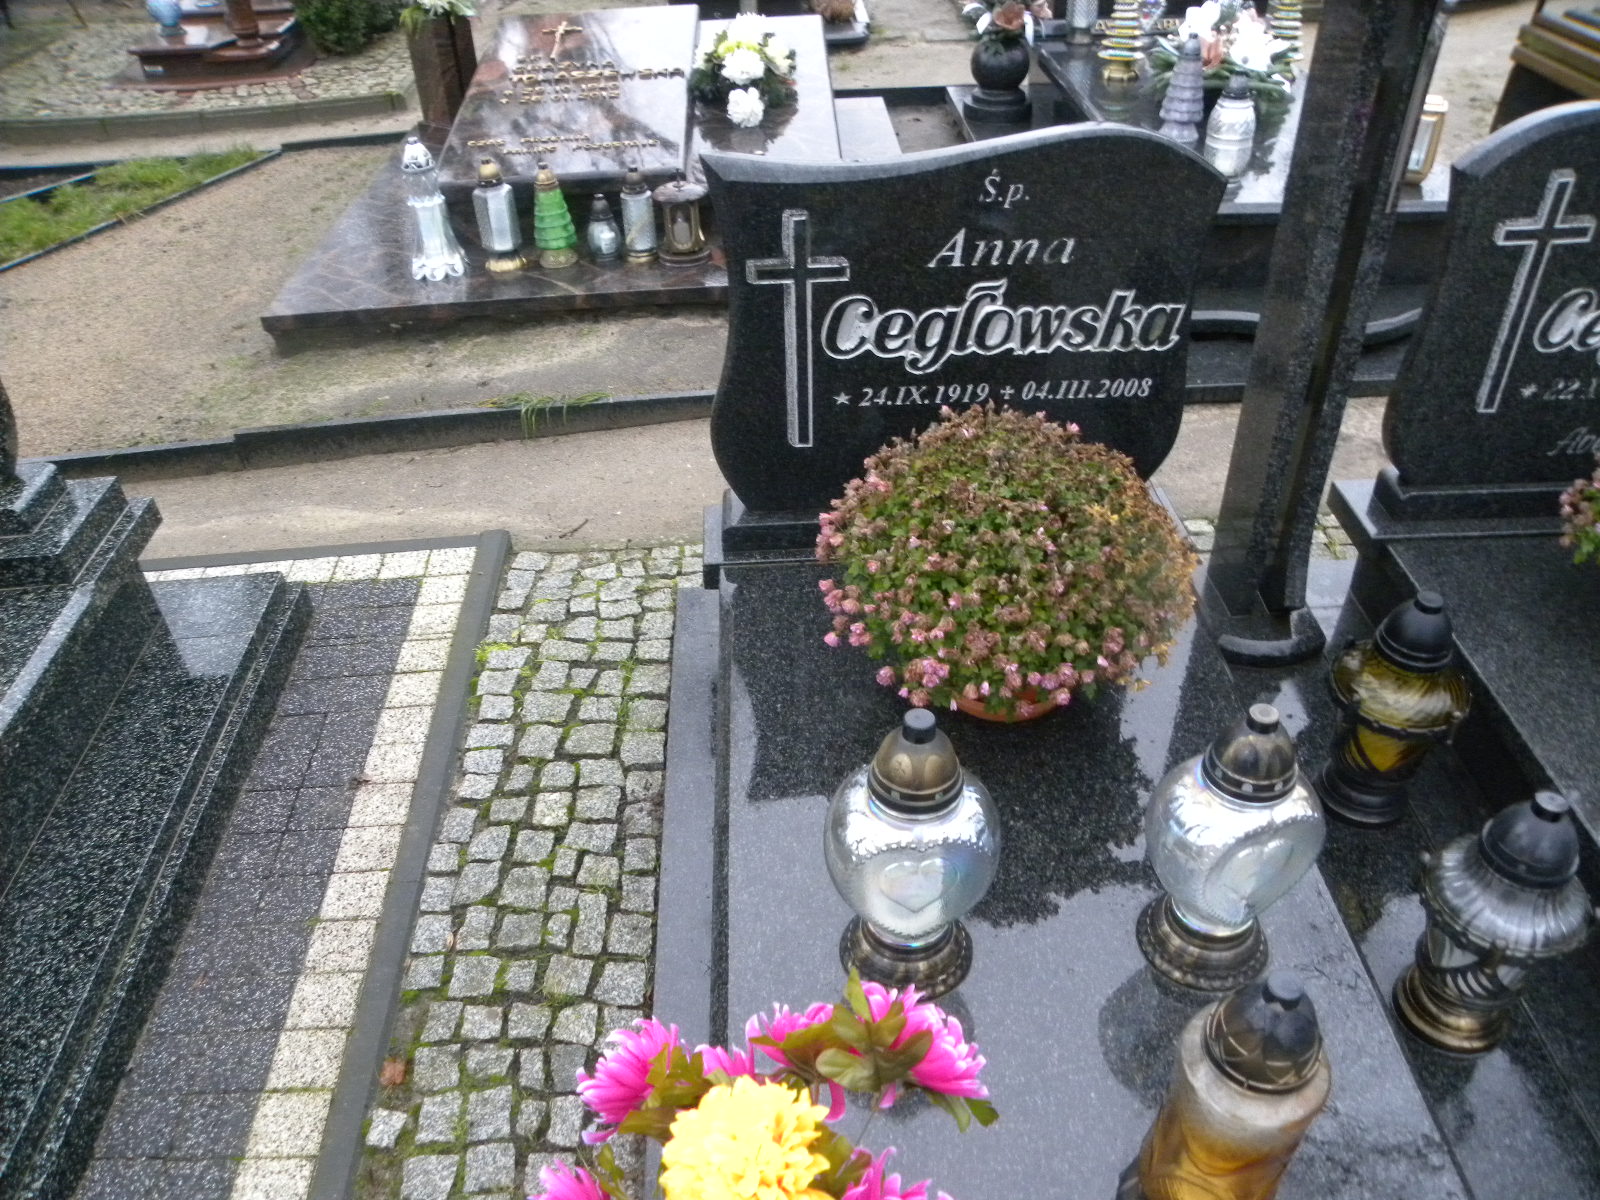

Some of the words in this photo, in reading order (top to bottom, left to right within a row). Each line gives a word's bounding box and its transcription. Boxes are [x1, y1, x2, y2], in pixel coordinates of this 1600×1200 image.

[978, 168, 1030, 208] Ś.p.
[926, 227, 1077, 268] Anna
[821, 277, 1187, 374] Cegłowska
[858, 383, 990, 407] 24.IX.1919
[1021, 377, 1153, 401] 04.III.2008
